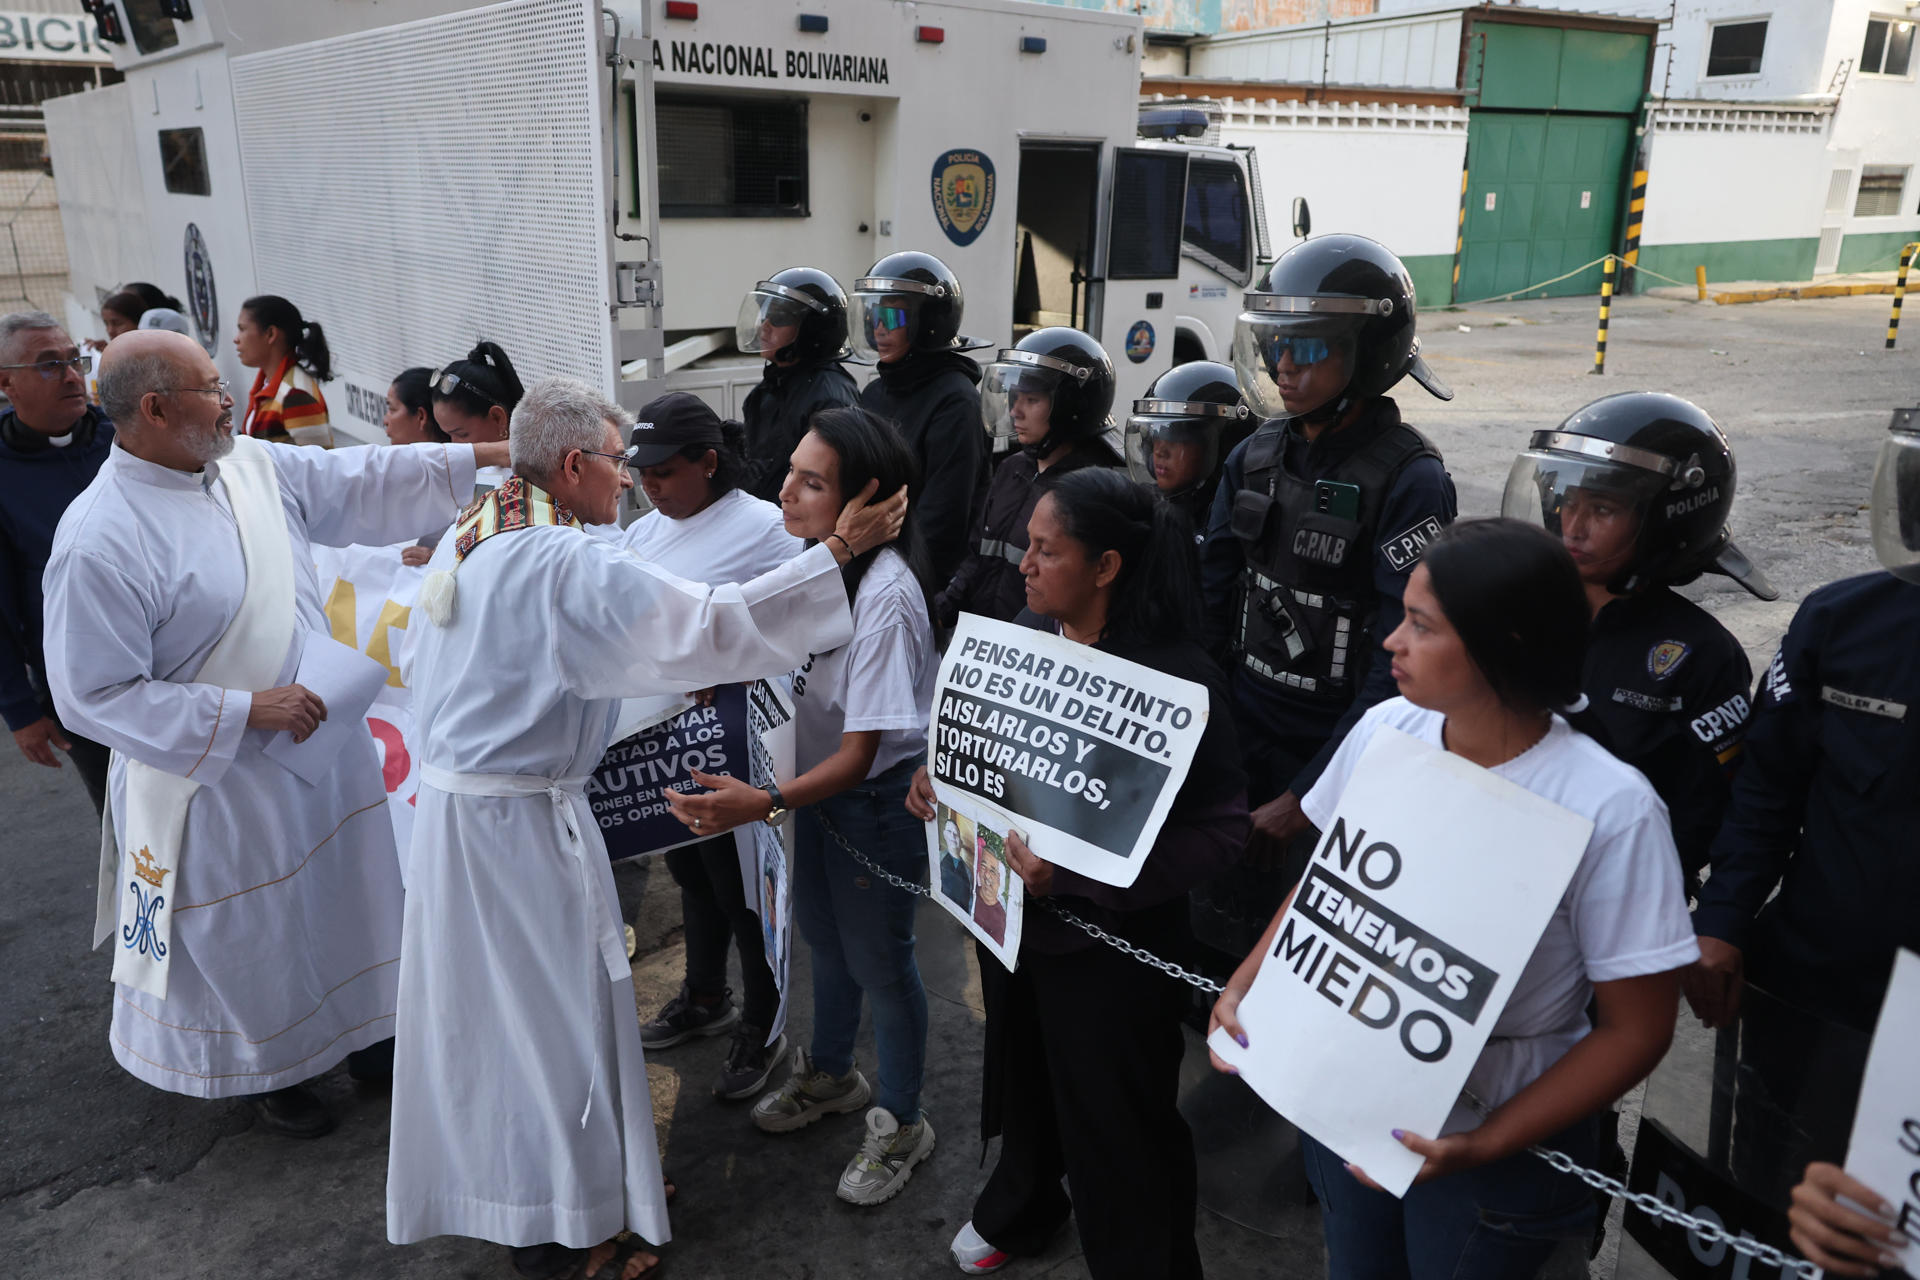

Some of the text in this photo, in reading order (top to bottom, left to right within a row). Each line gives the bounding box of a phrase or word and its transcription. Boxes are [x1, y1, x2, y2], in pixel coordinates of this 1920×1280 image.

[0, 16, 111, 54] BICI
[672, 40, 778, 79] NACIONAL
[785, 50, 889, 85] BOLIVARIANA
[949, 662, 1173, 758] NO ES UN DELITO.
[960, 636, 1192, 730] PENSAR DISTINTO
[665, 735, 681, 752] A
[685, 723, 726, 746] LOS
[940, 696, 1097, 764] AISLARLOS Y
[1691, 694, 1751, 743] CPNB
[936, 749, 1005, 799] SÍ LO ES
[937, 724, 1112, 810] TORTURARLOS,
[592, 794, 633, 813] ONER
[636, 787, 657, 803] EN
[600, 812, 625, 828] OS
[1320, 816, 1402, 890] NO
[1306, 875, 1474, 1001] TENEMOS
[1273, 917, 1453, 1064] MIEDO
